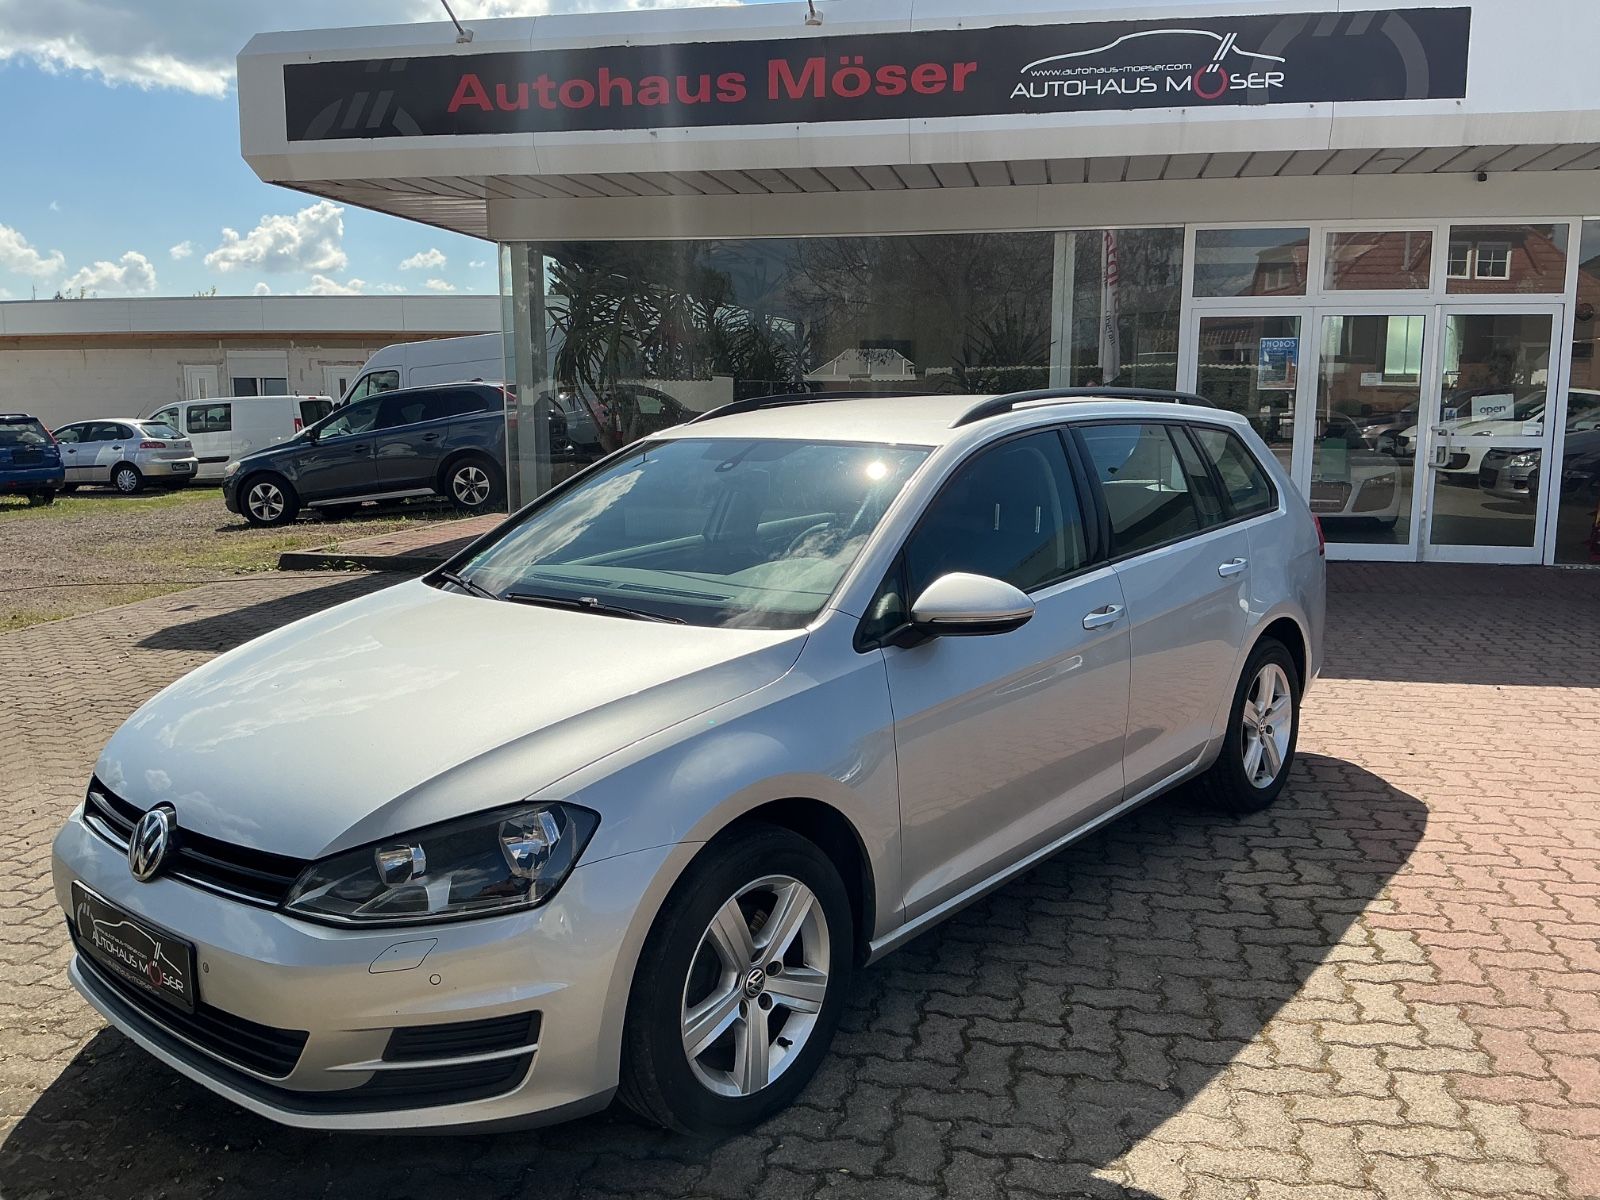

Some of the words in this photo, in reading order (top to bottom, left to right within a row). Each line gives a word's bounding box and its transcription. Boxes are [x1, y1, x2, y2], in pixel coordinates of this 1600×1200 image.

[446, 67, 747, 113] Autohaus
[768, 55, 978, 100] Möser
[1010, 76, 1158, 99] AUTOHAUS
[1165, 63, 1286, 100] MÖSER
[1031, 62, 1193, 77] www.autohaus-moeser.com
[1479, 404, 1507, 415] open
[92, 928, 138, 968] AUTOHAUS
[138, 959, 184, 993] MÖSER
